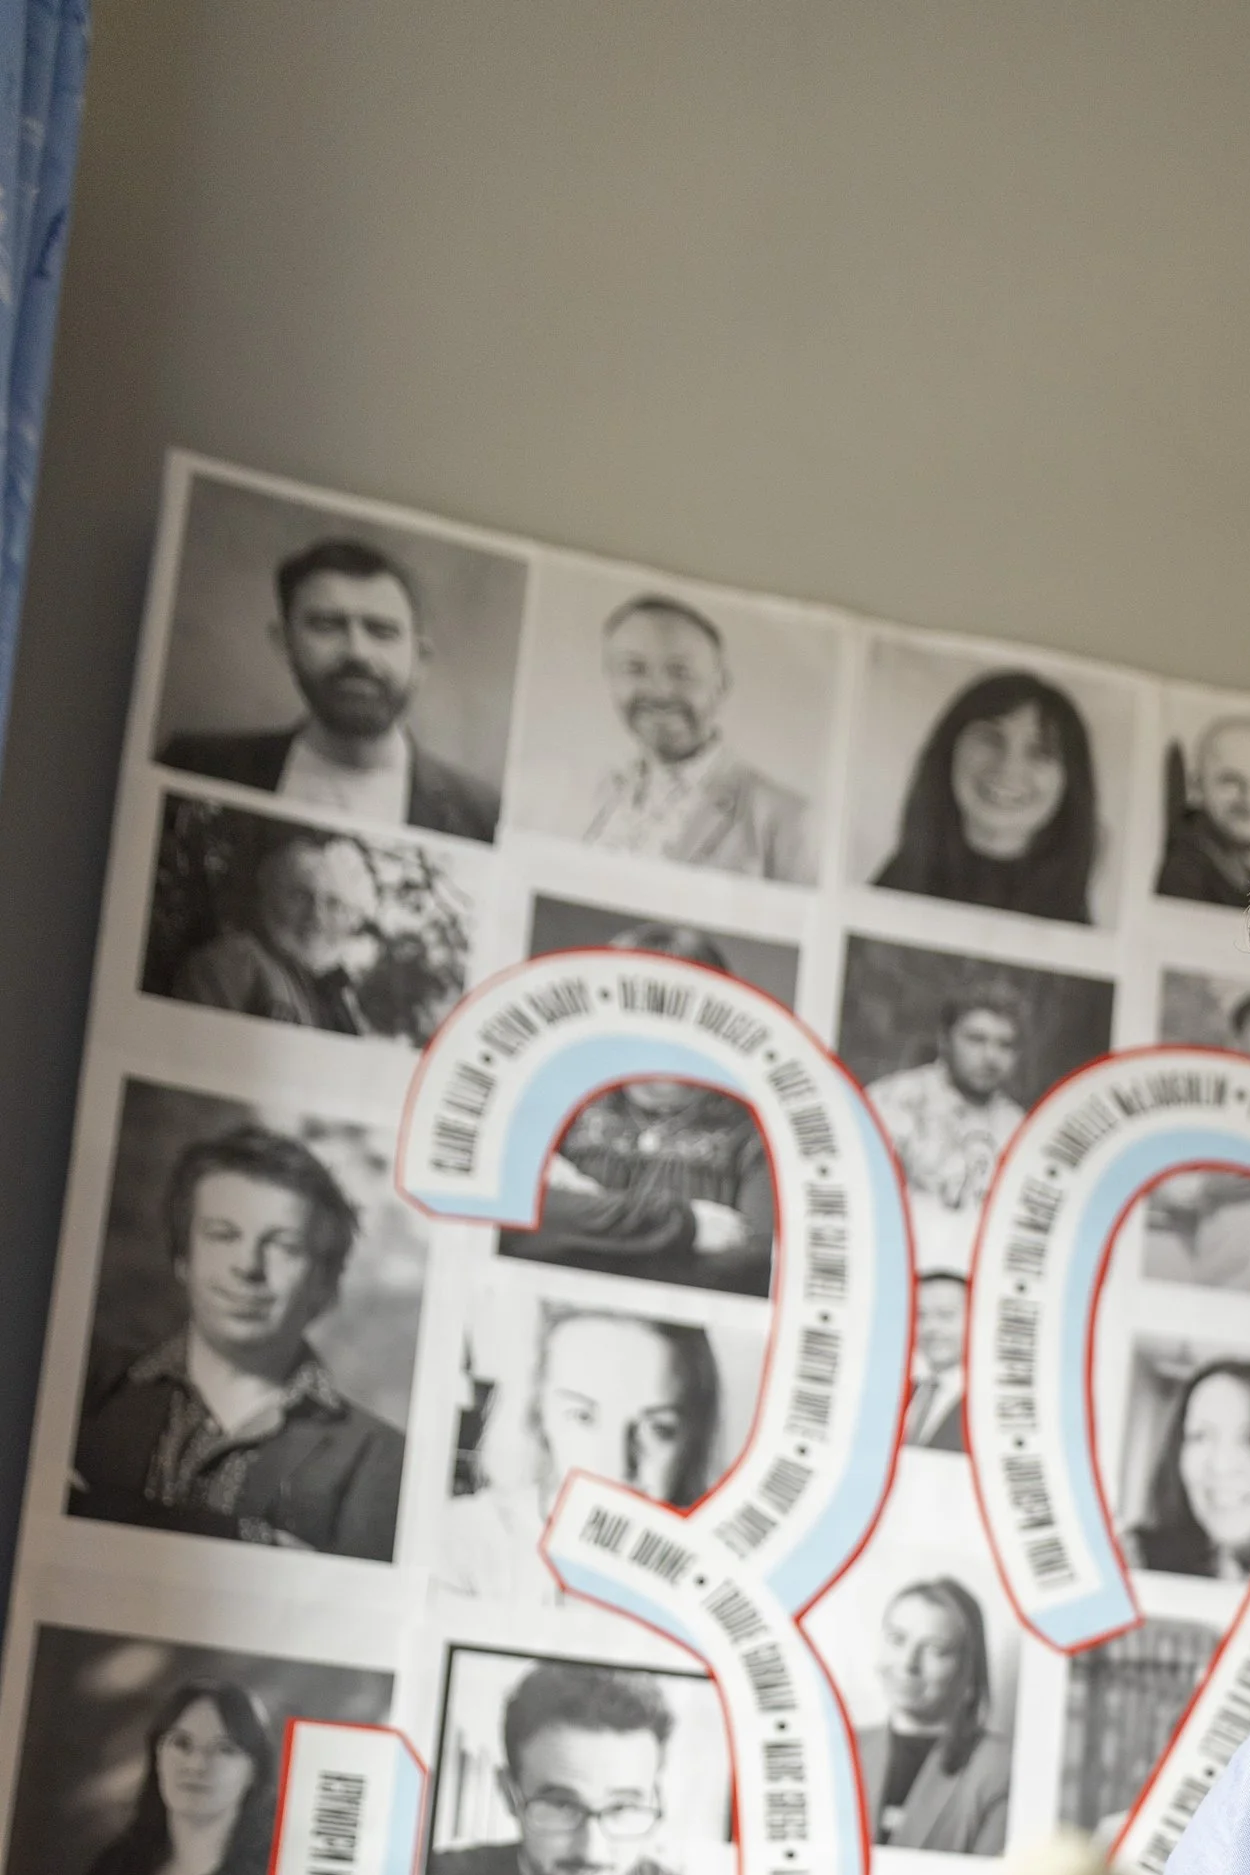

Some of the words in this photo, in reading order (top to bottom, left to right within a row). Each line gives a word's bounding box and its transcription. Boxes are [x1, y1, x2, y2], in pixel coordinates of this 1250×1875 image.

[697, 997, 768, 1055] BOLGER
[446, 1062, 496, 1119] ALLAN
[430, 1119, 479, 1177] CLAIRE
[806, 1182, 847, 1218] JUNE
[580, 1505, 630, 1556] PAUL
[632, 1529, 694, 1586] DUNNE
[705, 1580, 768, 1643] TRUDIE
[741, 1643, 799, 1713] GORMAN
[762, 1739, 806, 1784] MARC
[309, 1769, 366, 1865] McDONAGH
